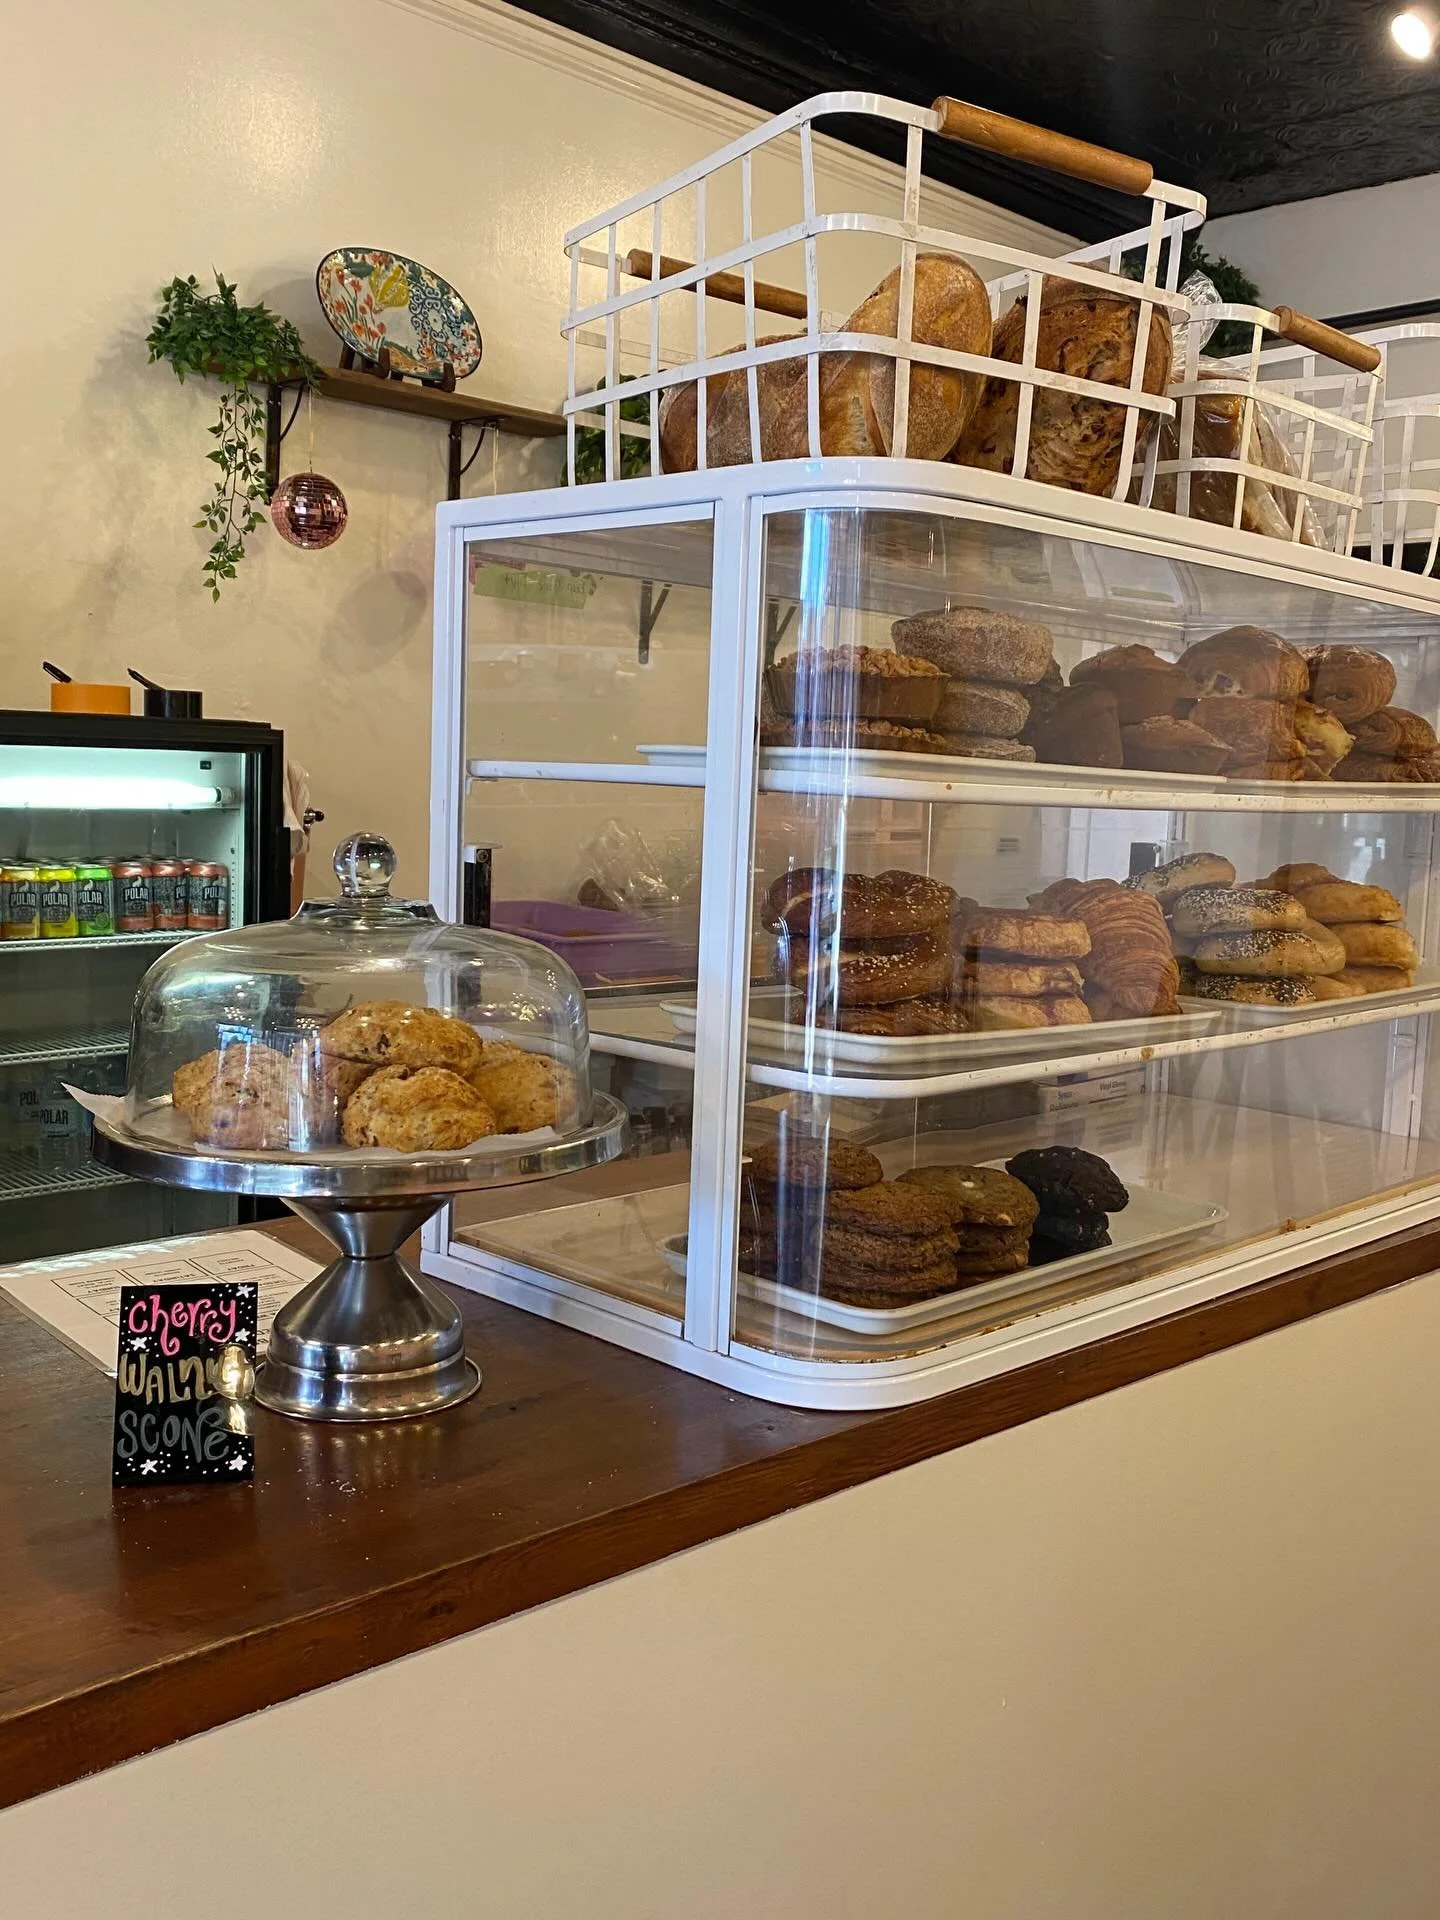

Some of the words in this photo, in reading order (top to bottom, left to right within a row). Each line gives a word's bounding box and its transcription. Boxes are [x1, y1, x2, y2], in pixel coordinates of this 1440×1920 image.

[10, 892, 36, 907] POLAR
[42, 892, 68, 908] POLAR
[77, 890, 103, 905] POLAR
[124, 886, 149, 901] POLAR
[39, 1108, 69, 1125] POLAR
[128, 1293, 237, 1356] Cherry
